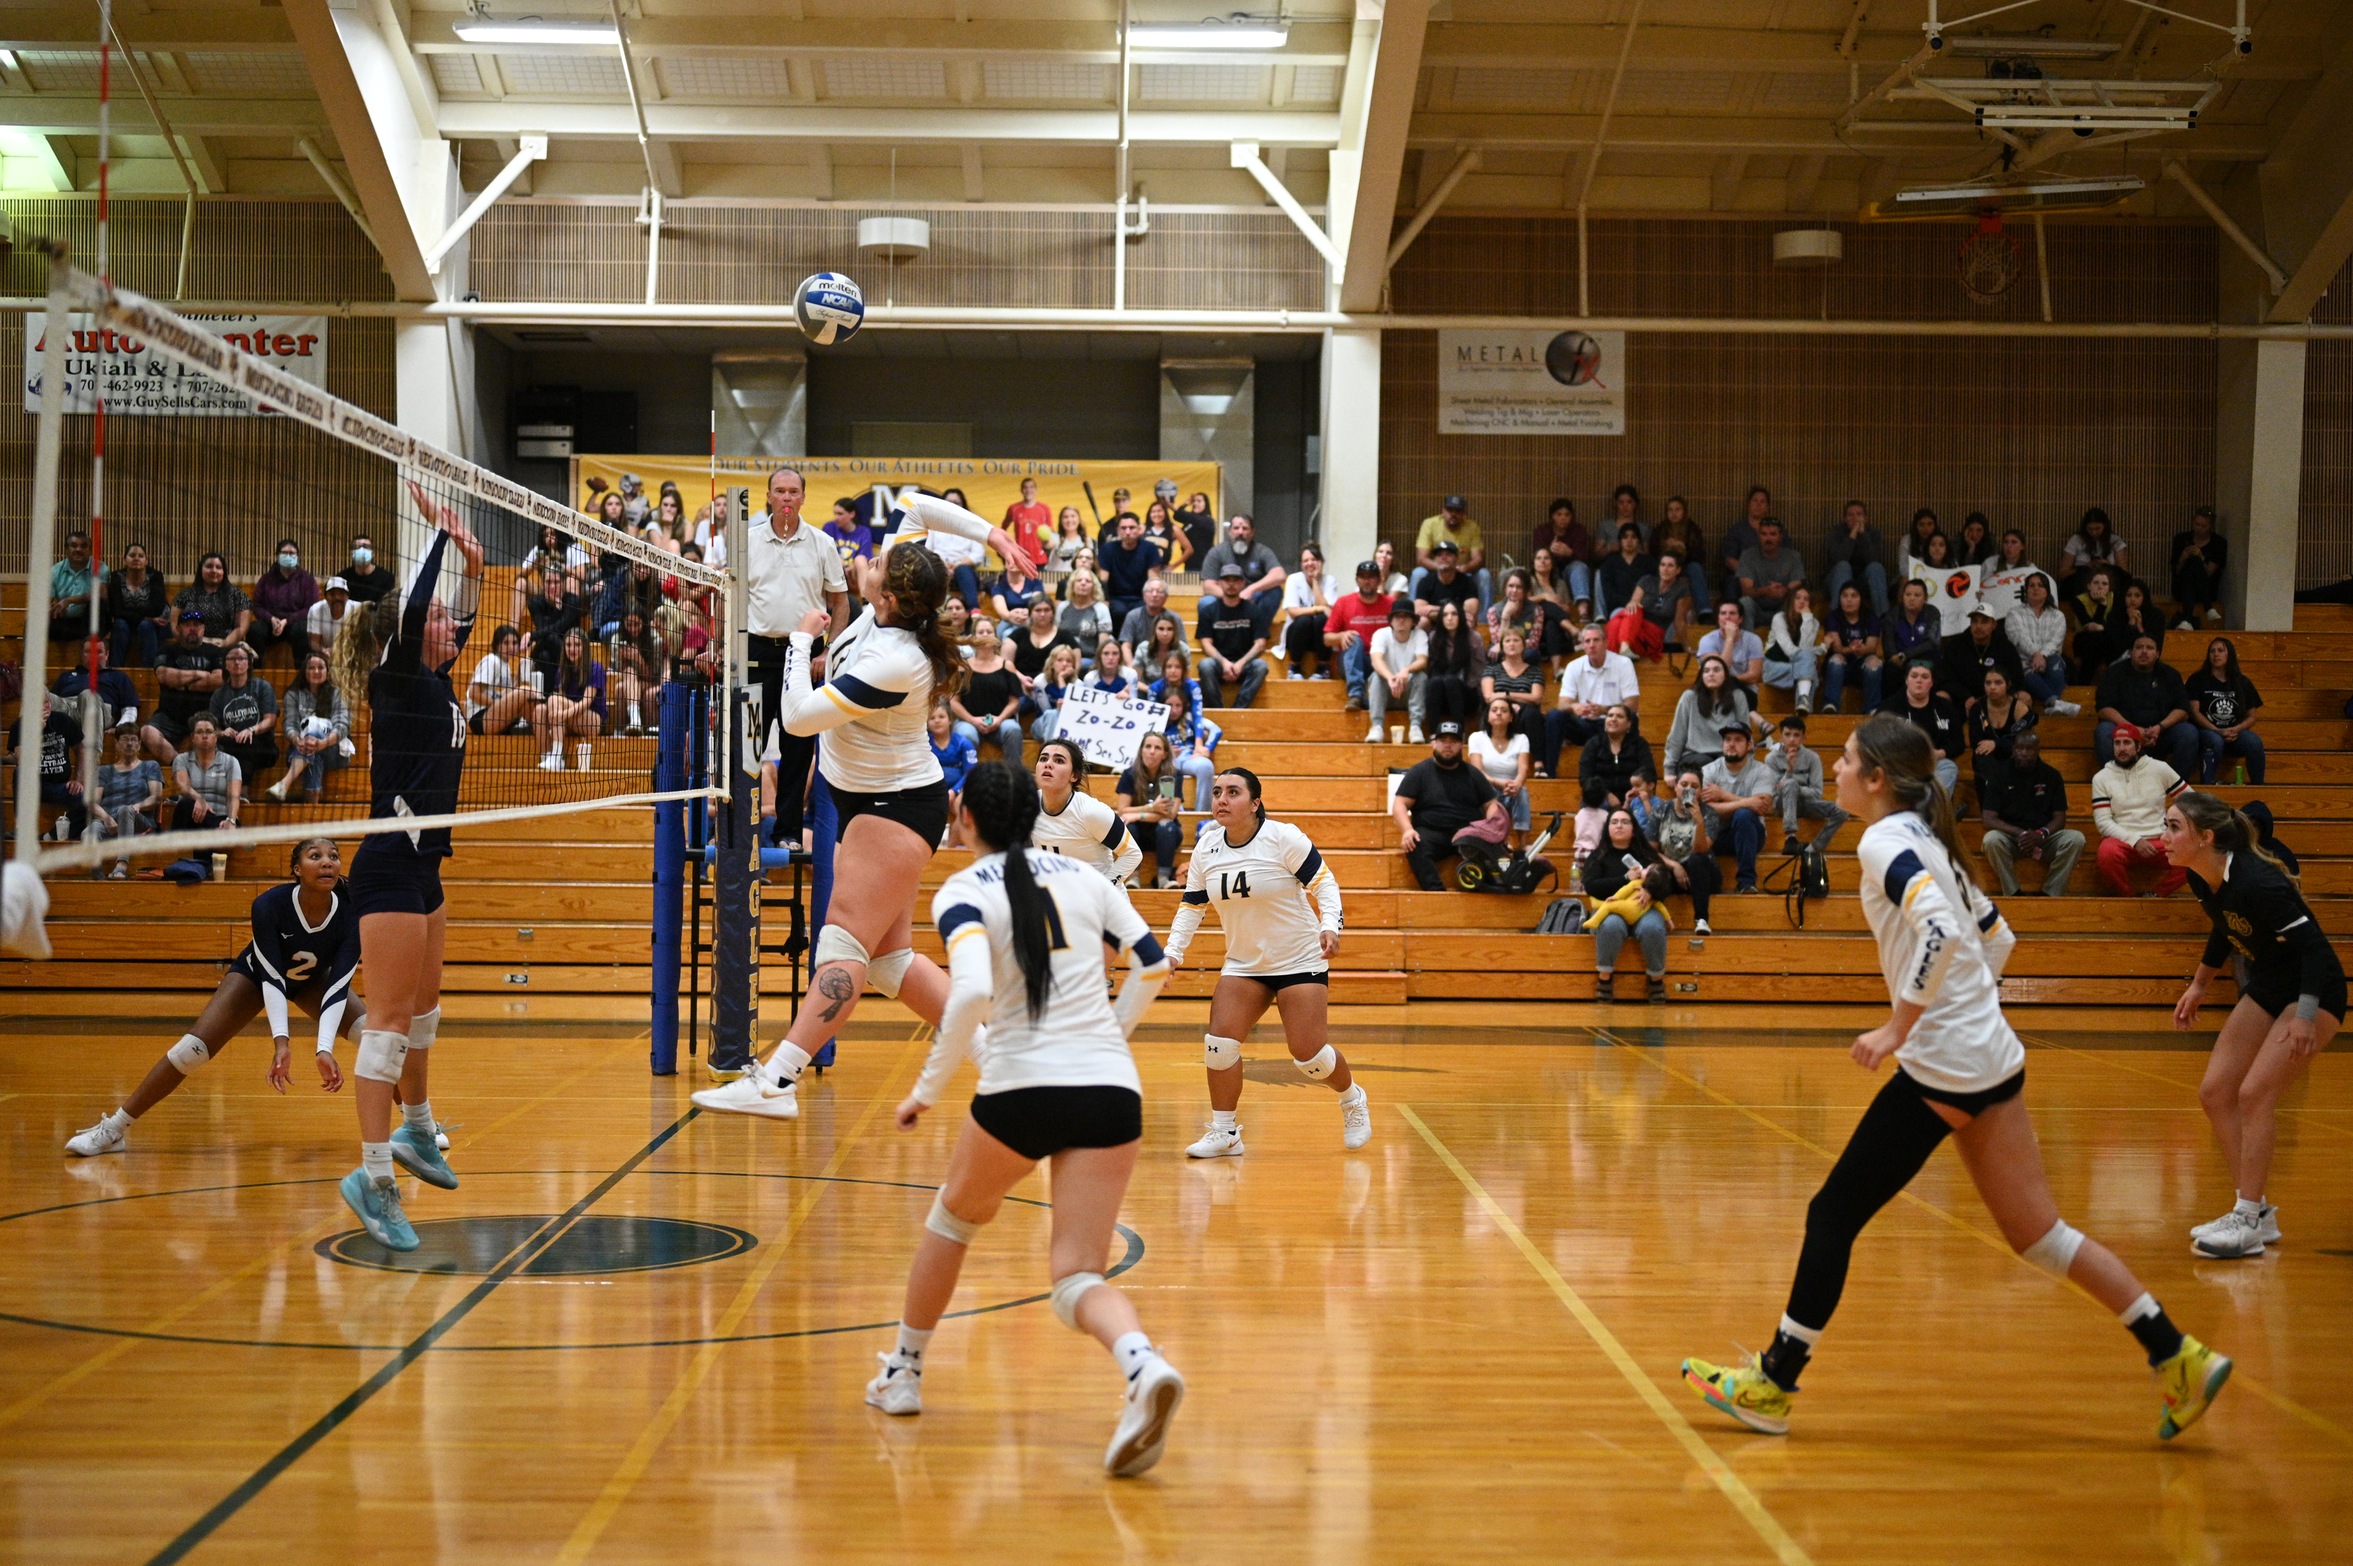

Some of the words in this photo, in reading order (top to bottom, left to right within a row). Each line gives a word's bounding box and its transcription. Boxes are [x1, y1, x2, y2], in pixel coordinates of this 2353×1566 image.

[819, 282, 857, 297] molten
[821, 293, 855, 309] NCAA
[1457, 346, 1539, 362] METAL
[64, 359, 136, 376] Ukiah
[147, 360, 168, 377] &
[80, 380, 163, 393] 70-462-9923
[104, 395, 247, 411] www.GuySellsCars.com
[850, 459, 890, 473] OUR
[983, 460, 1022, 475] OUR
[1069, 686, 1110, 705] LET'S
[1221, 871, 1251, 900] 14
[748, 787, 761, 1058] EAGLES
[286, 950, 318, 981] 2
